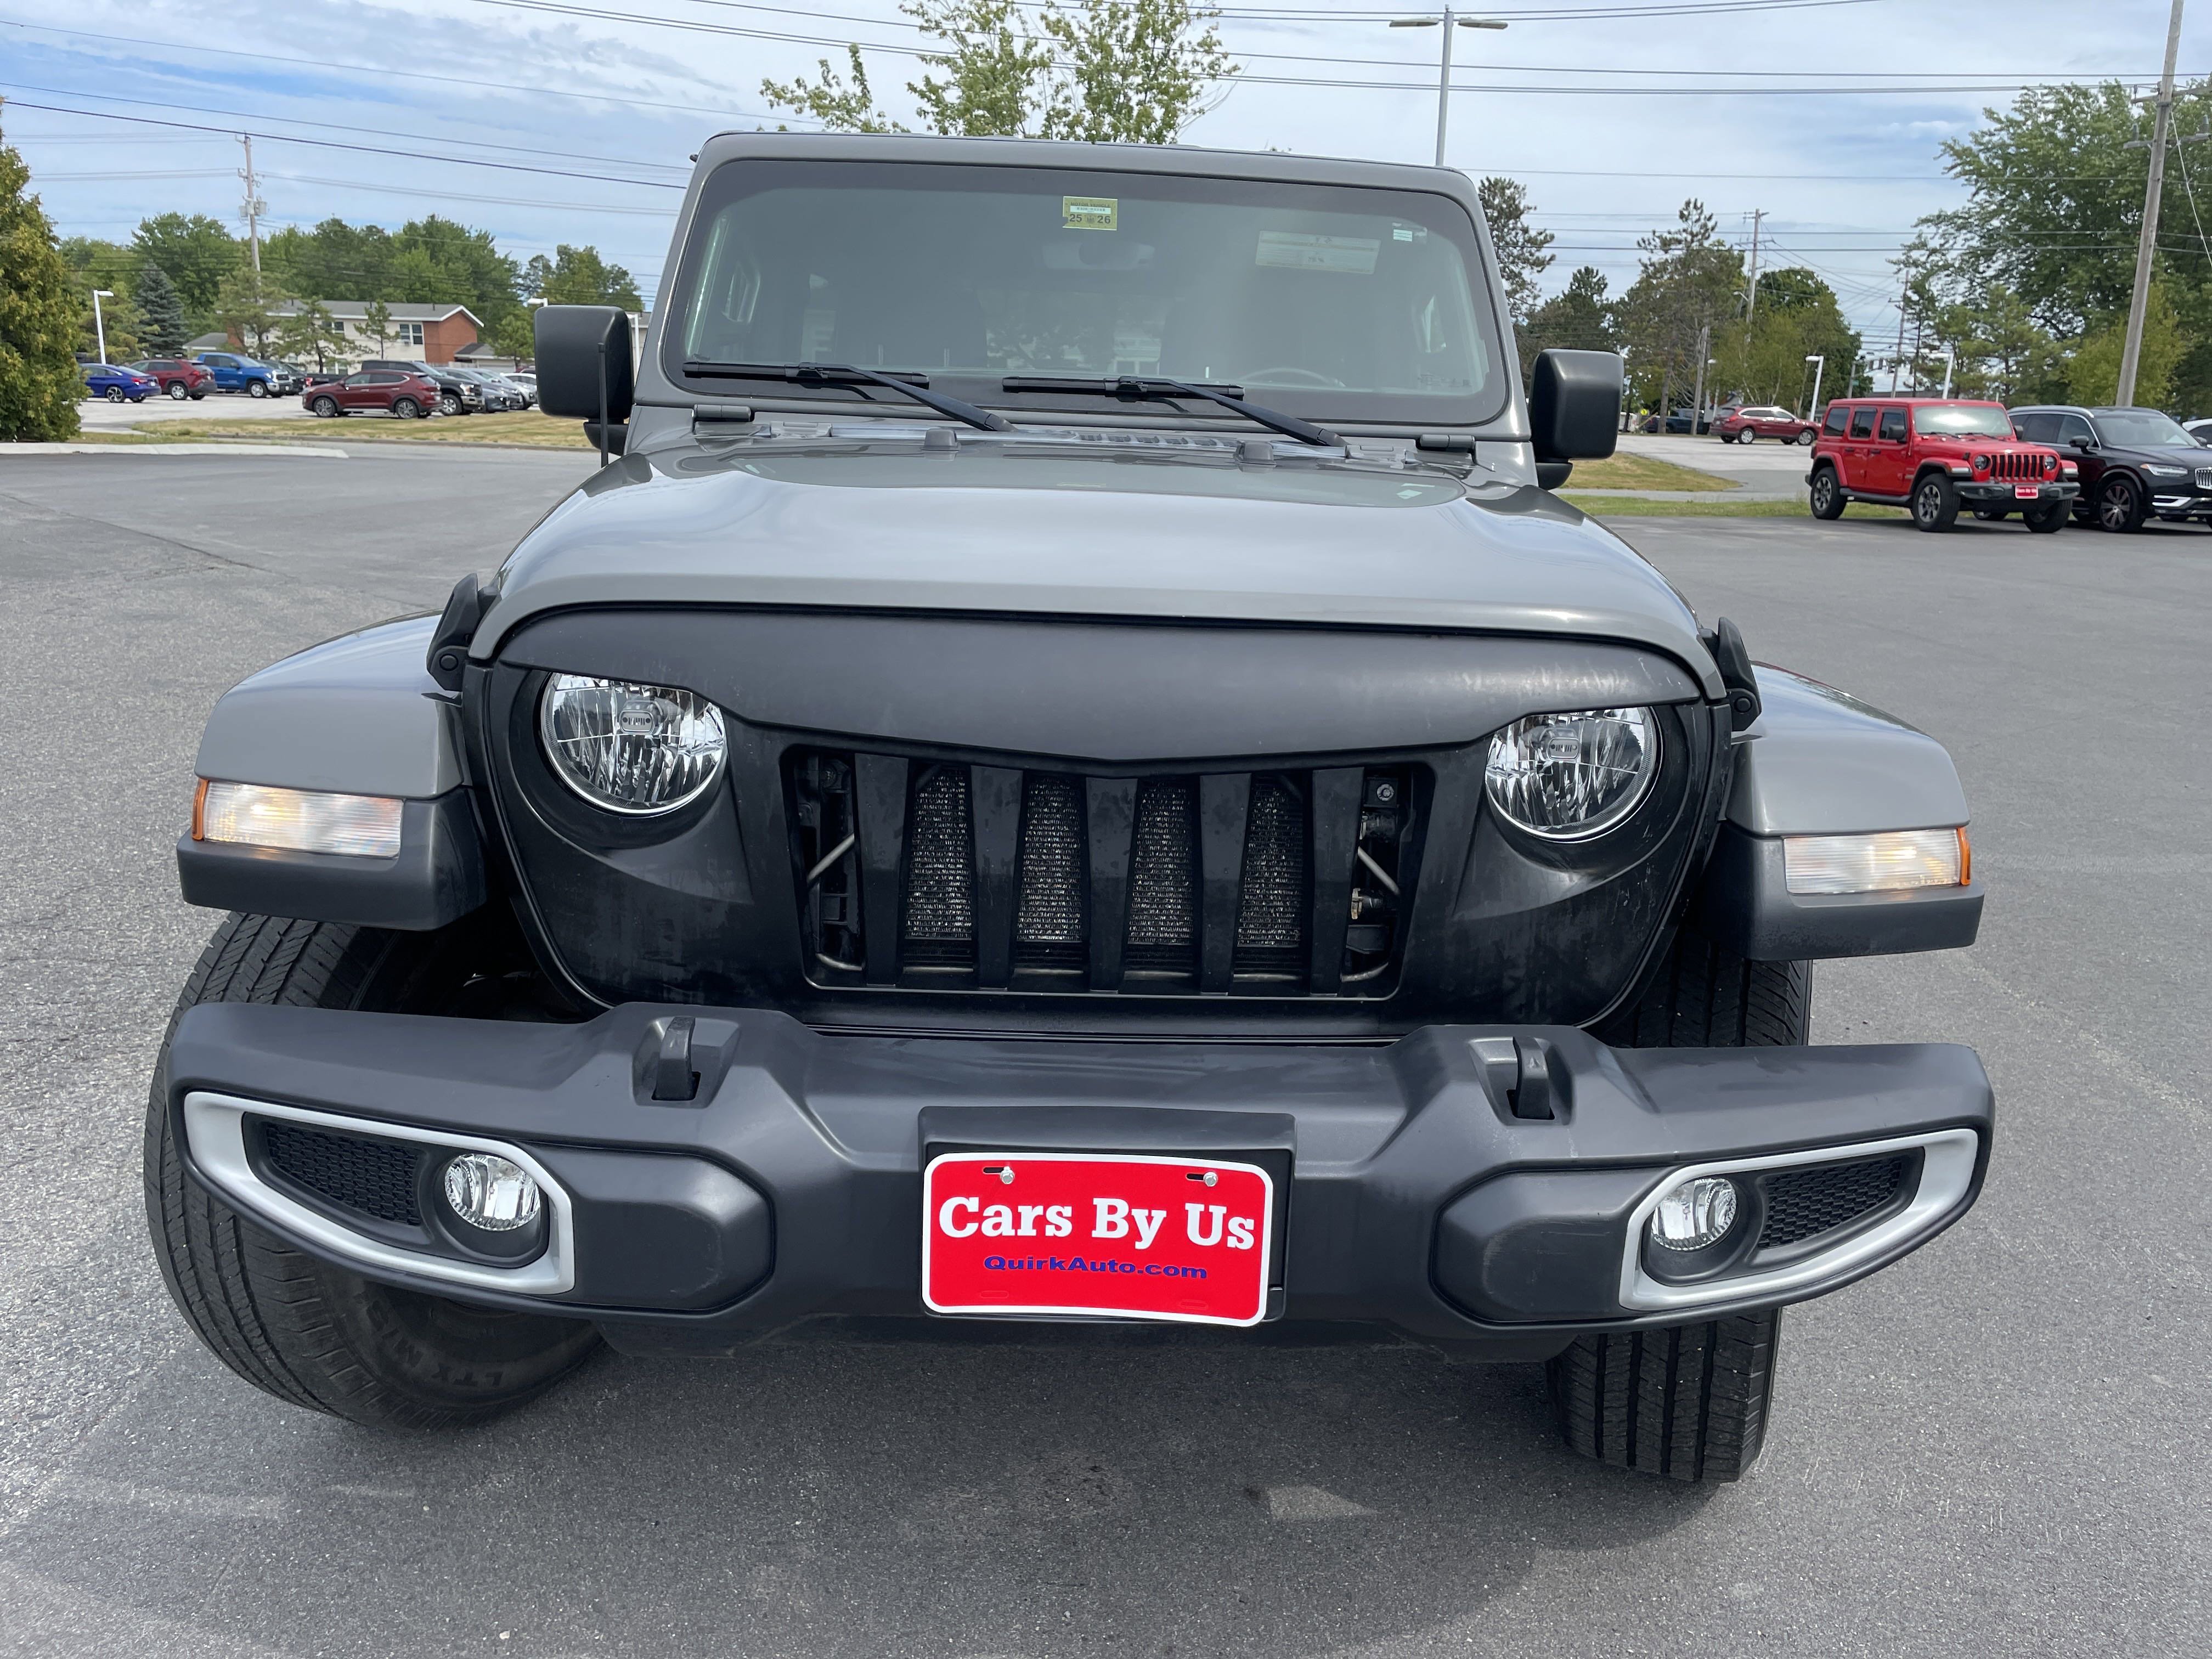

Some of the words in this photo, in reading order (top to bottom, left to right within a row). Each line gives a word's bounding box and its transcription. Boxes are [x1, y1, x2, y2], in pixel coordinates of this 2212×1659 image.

[1070, 213, 1082, 222] 25
[1097, 215, 1111, 224] 26
[939, 1197, 1073, 1238] Cars
[1092, 1198, 1166, 1250] By
[1185, 1202, 1255, 1250] Us
[984, 1256, 1207, 1279] QuirkAuto.com
[431, 1363, 504, 1387] LTX
